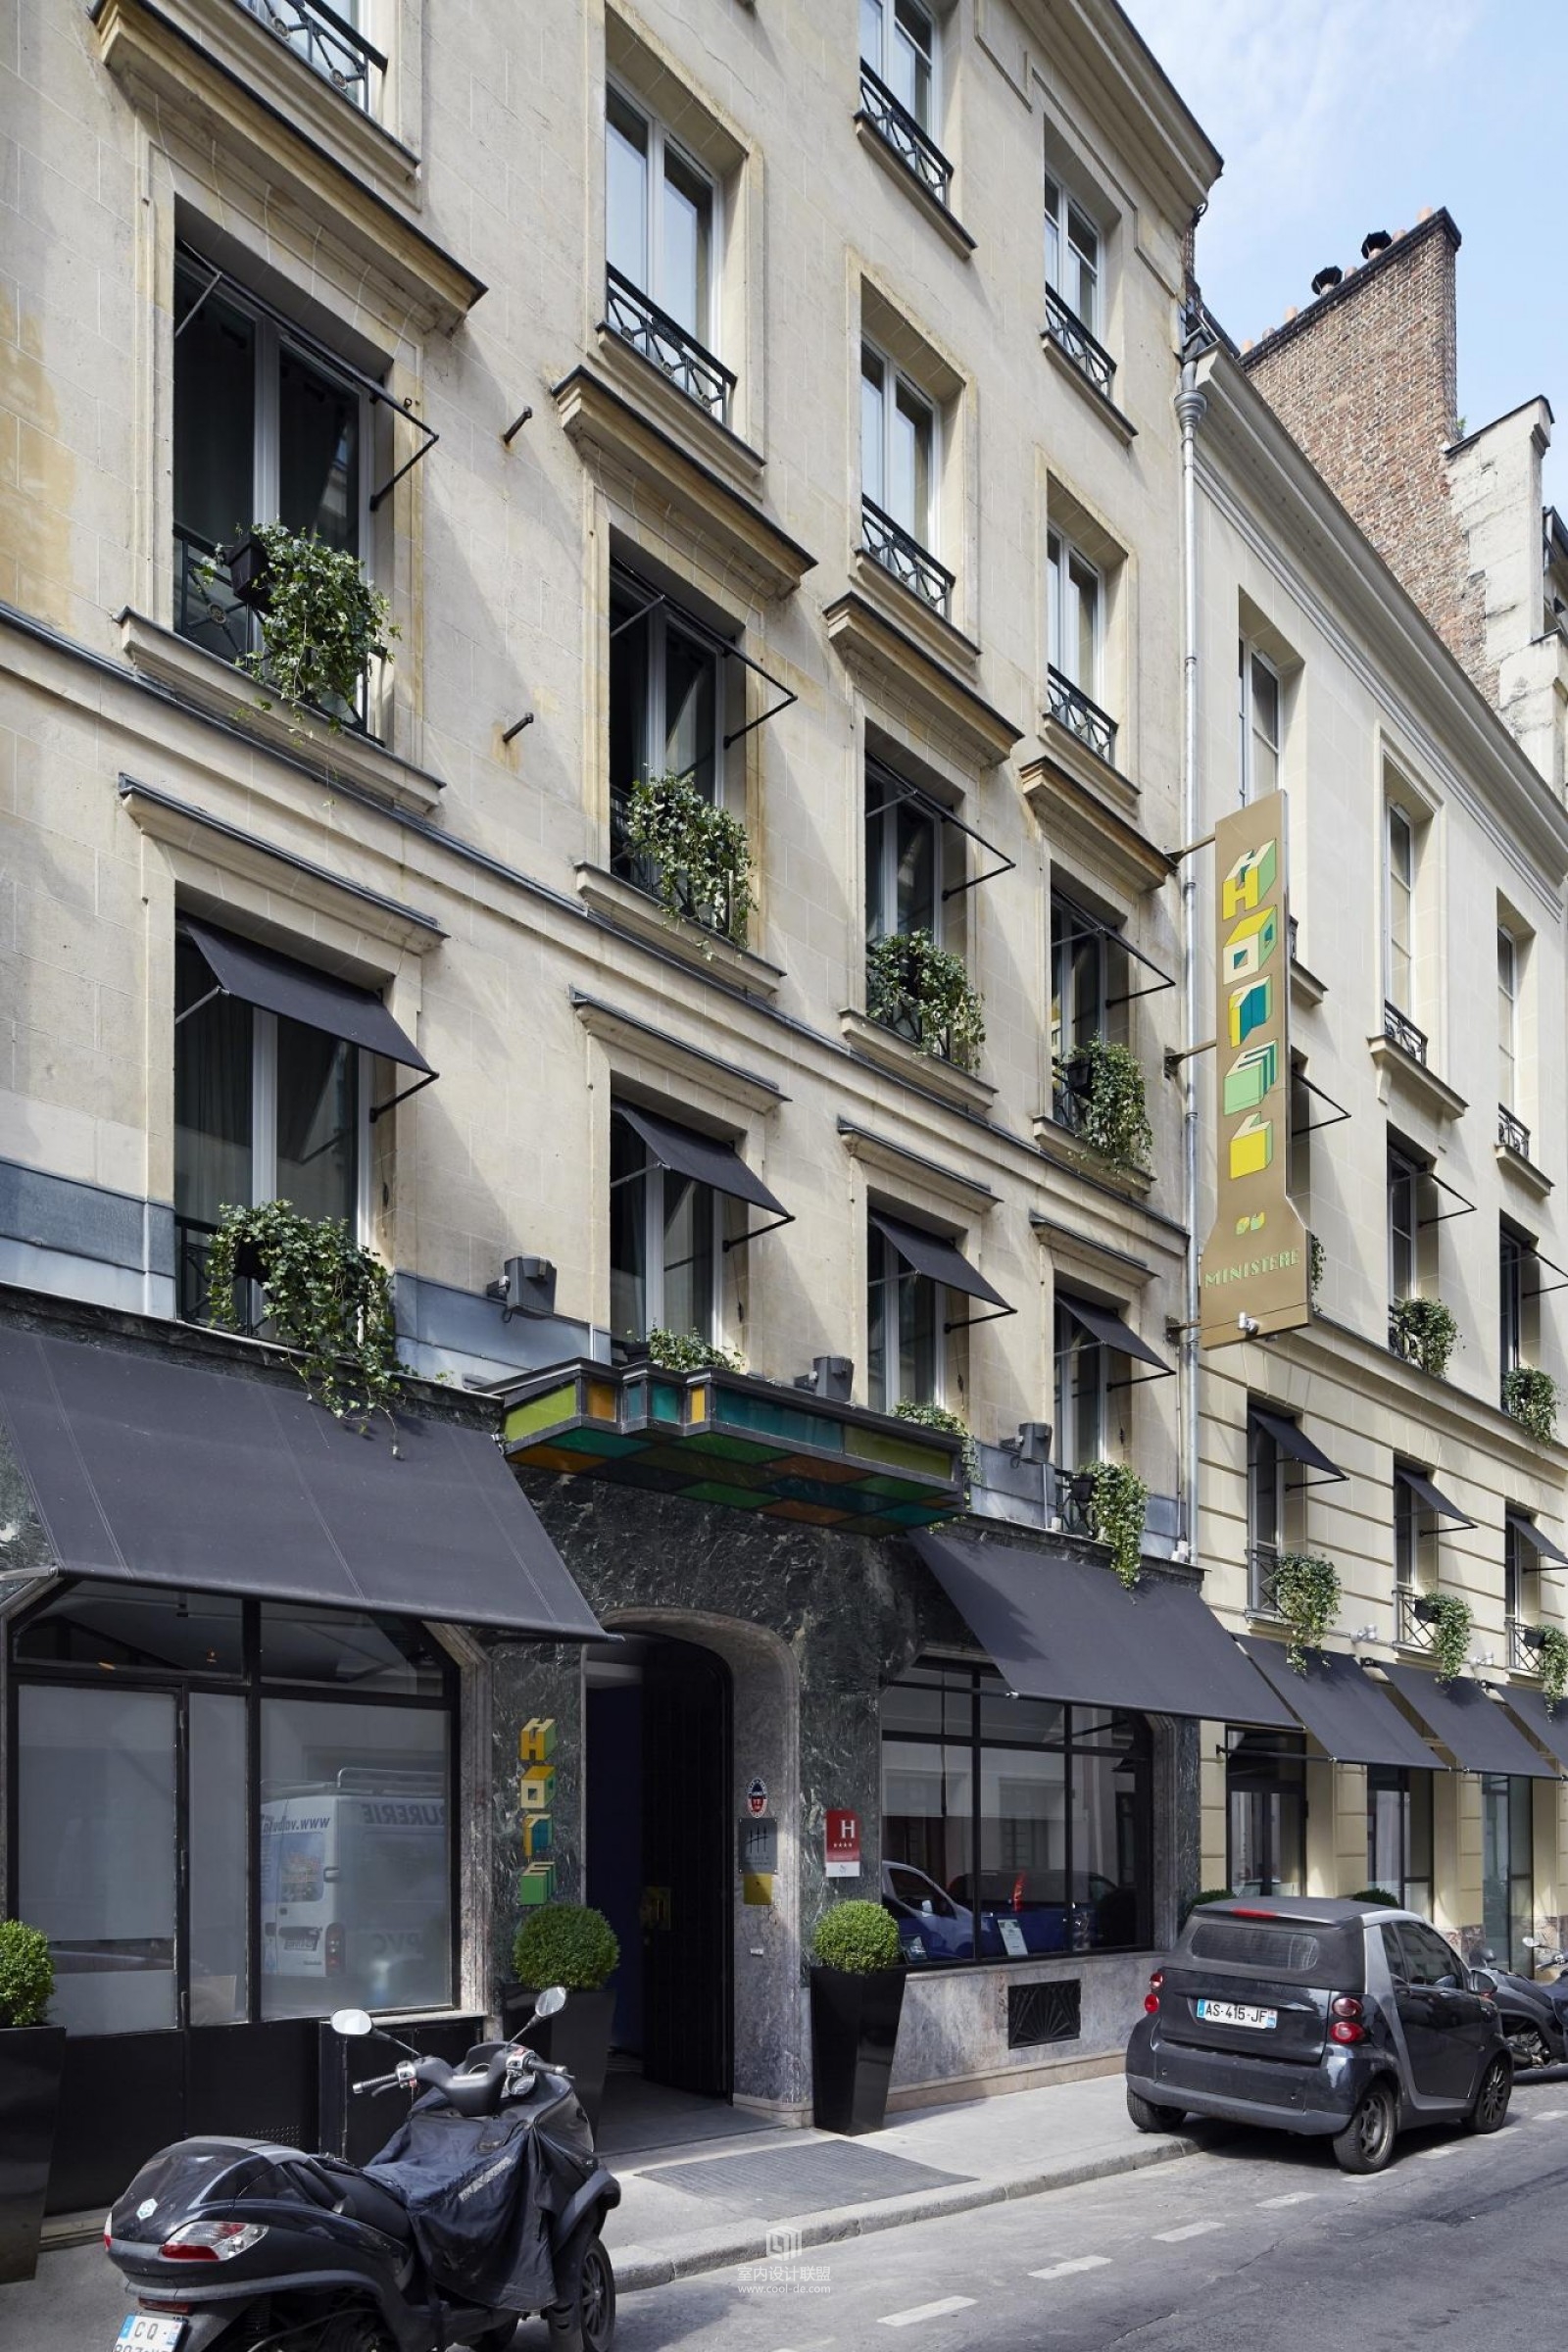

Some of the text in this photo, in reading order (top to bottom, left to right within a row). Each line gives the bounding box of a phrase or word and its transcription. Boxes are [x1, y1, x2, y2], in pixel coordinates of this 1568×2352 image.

[1222, 838, 1278, 1180] HOTEL
[519, 1717, 557, 1906] HOTE
[841, 1819, 855, 1838] H
[1205, 2002, 1267, 2023] AS-415-JF
